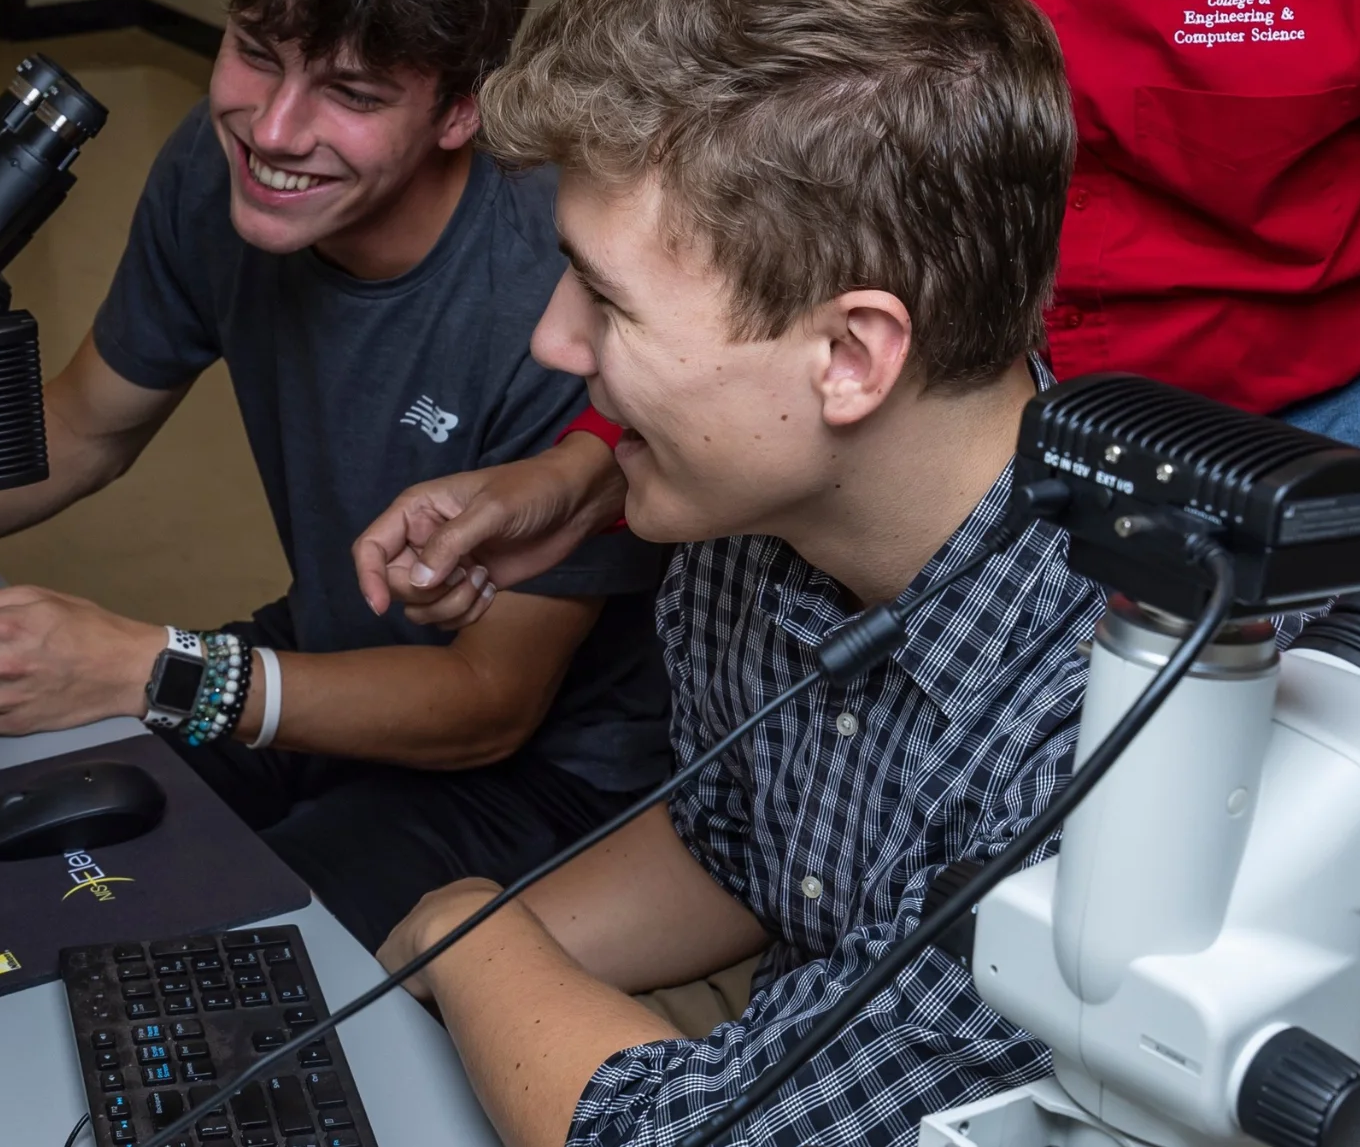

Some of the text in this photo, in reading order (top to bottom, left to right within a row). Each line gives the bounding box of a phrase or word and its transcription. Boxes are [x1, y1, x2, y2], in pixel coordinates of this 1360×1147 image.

[1183, 7, 1295, 28] Engineering &
[1174, 27, 1306, 48] Computer Science
[1044, 451, 1060, 467] DC
[1059, 458, 1071, 471] IN
[1095, 470, 1117, 488] EXT
